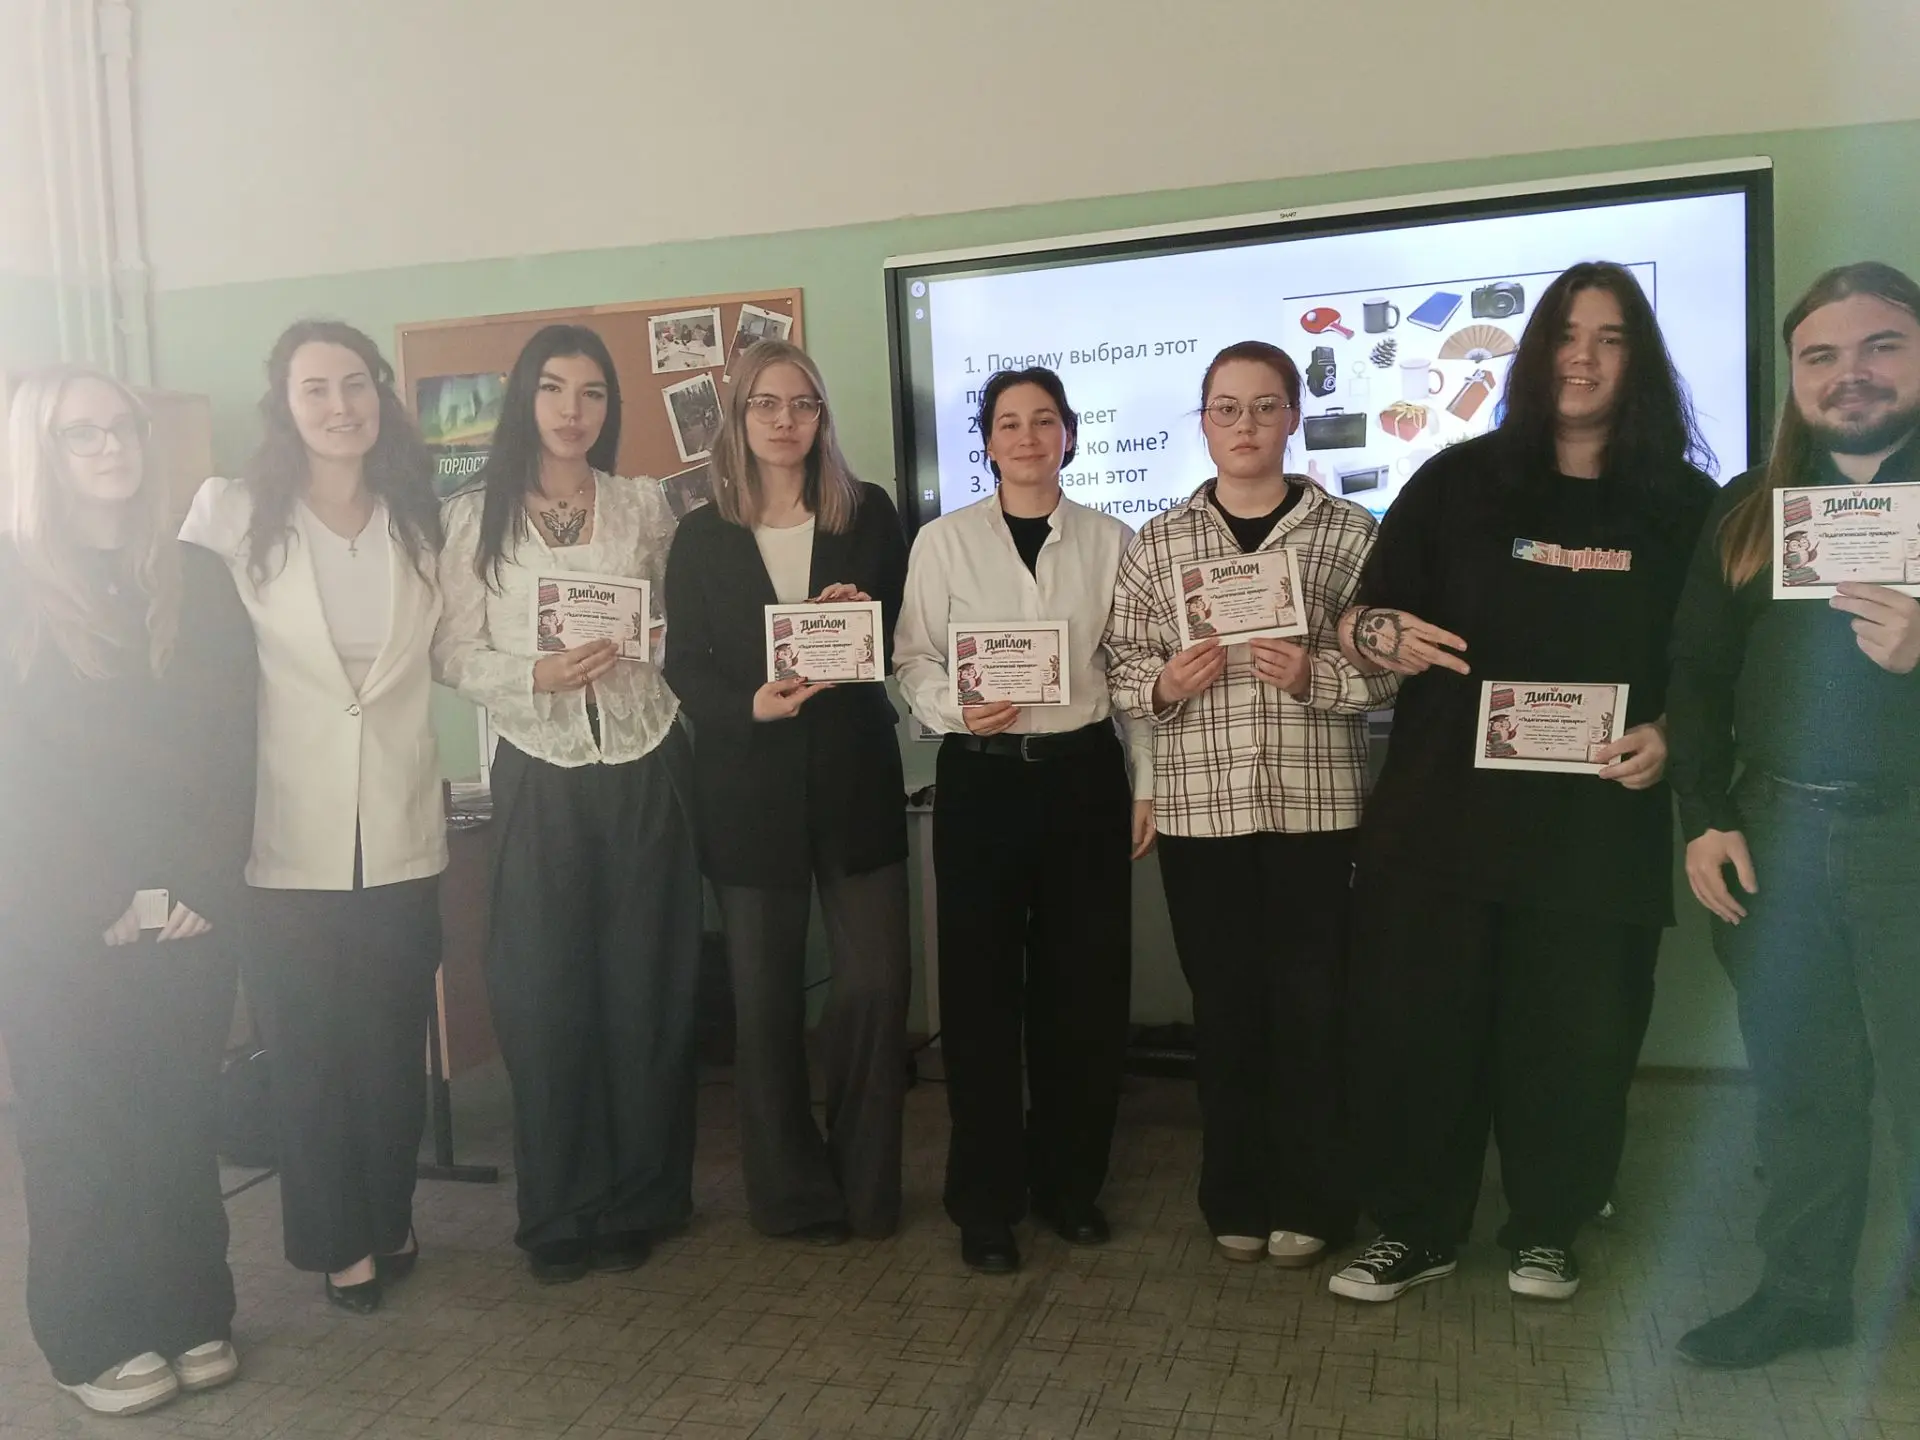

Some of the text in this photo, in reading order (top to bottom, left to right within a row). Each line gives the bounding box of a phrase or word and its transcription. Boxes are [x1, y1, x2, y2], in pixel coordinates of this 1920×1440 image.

[965, 338, 1198, 374] 1. Почему выбрал этот
[1087, 441, 1109, 455] ко
[1116, 431, 1169, 452] мне?
[970, 475, 987, 493] 3.
[1105, 468, 1148, 485] этот
[1822, 497, 1892, 517] ДИПЛОМ
[1210, 563, 1260, 583] ДИПЛОМ
[568, 587, 616, 604] ДИПЛОМ
[800, 619, 846, 633] ДИПЛОМ
[984, 638, 1032, 653] ДИПЛОМ
[1524, 691, 1583, 705] ДИПЛОМ
